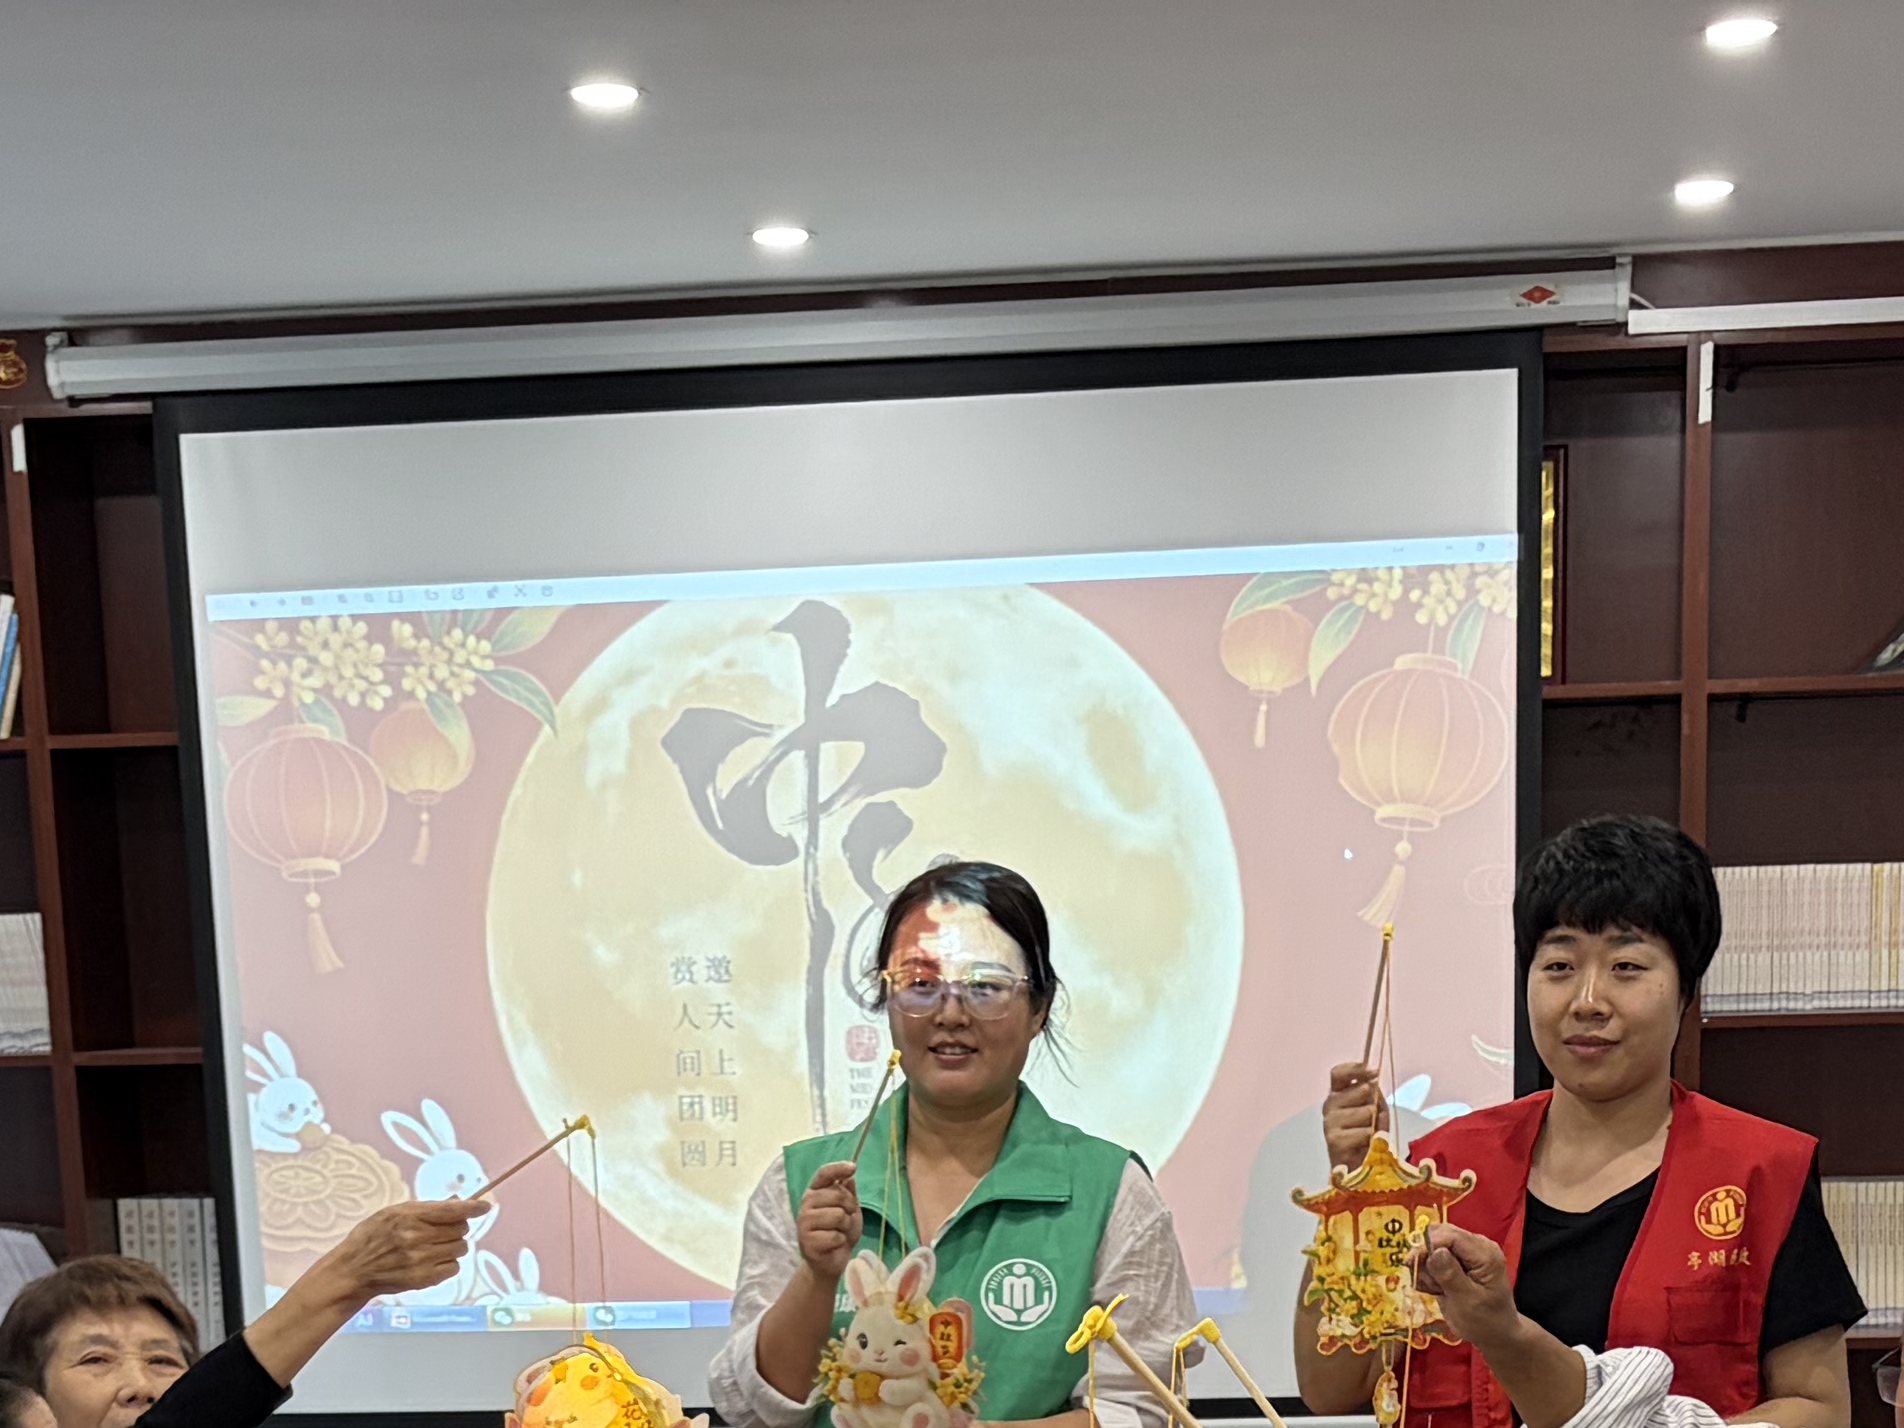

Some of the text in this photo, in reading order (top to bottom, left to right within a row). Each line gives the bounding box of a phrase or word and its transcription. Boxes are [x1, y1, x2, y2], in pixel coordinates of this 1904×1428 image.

[670, 955, 707, 1168] 赏人间团圆
[704, 954, 738, 1167] 邀天上明月
